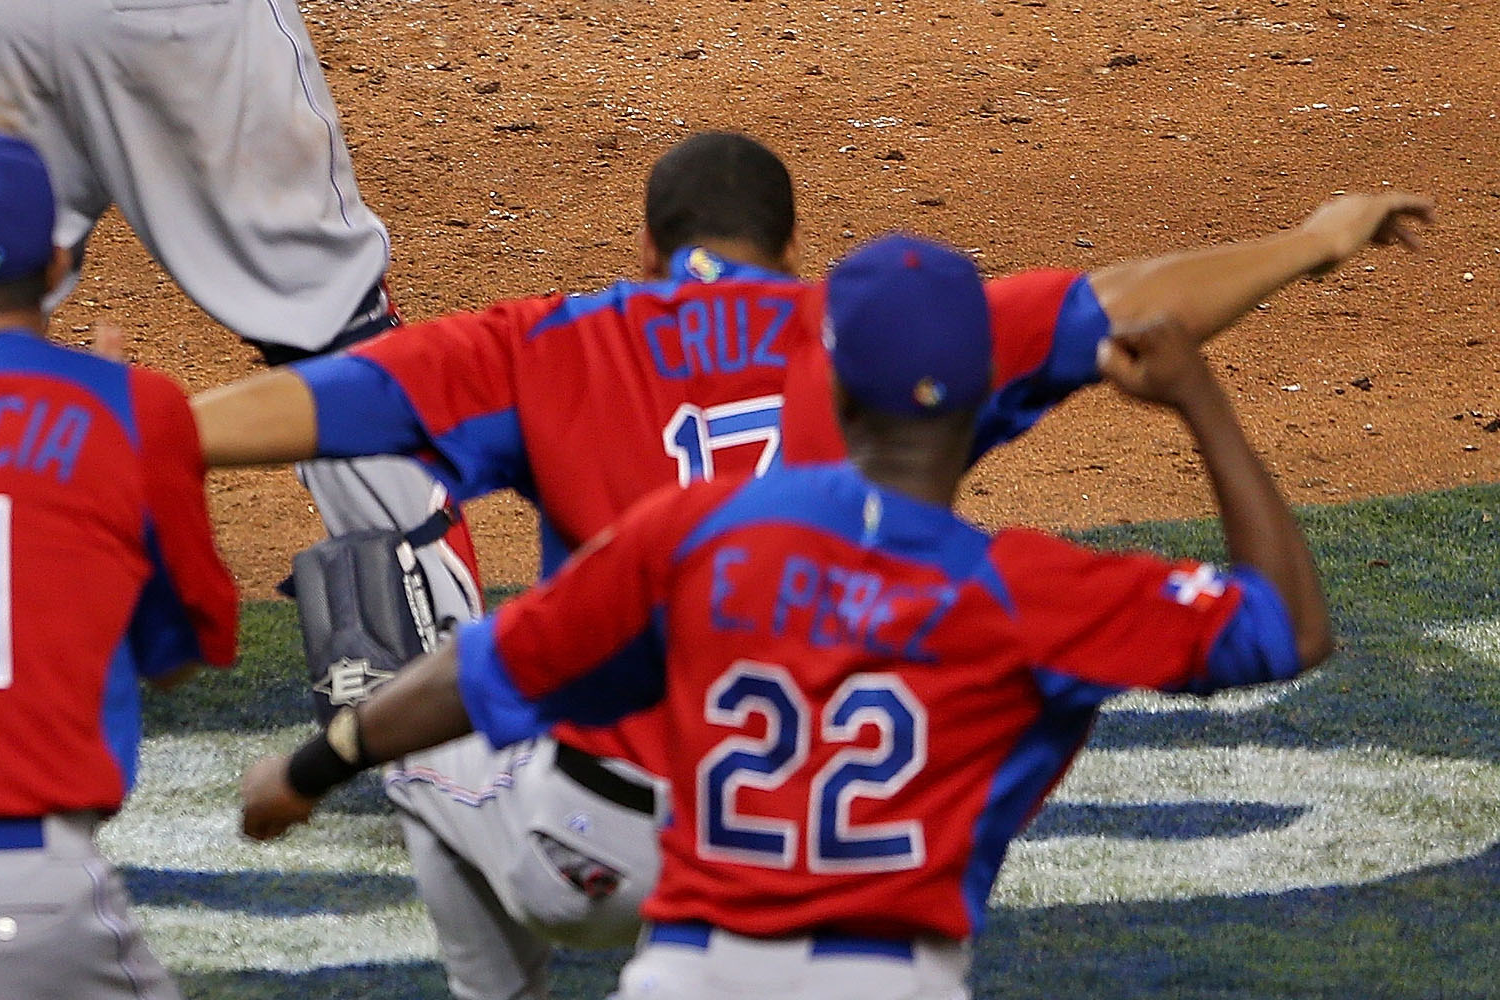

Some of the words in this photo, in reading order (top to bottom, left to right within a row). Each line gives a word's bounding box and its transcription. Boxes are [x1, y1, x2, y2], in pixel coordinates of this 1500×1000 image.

[644, 297, 794, 380] CRUZ
[662, 394, 785, 490] 17
[772, 555, 960, 663] PEREZ
[696, 658, 928, 875] 22
